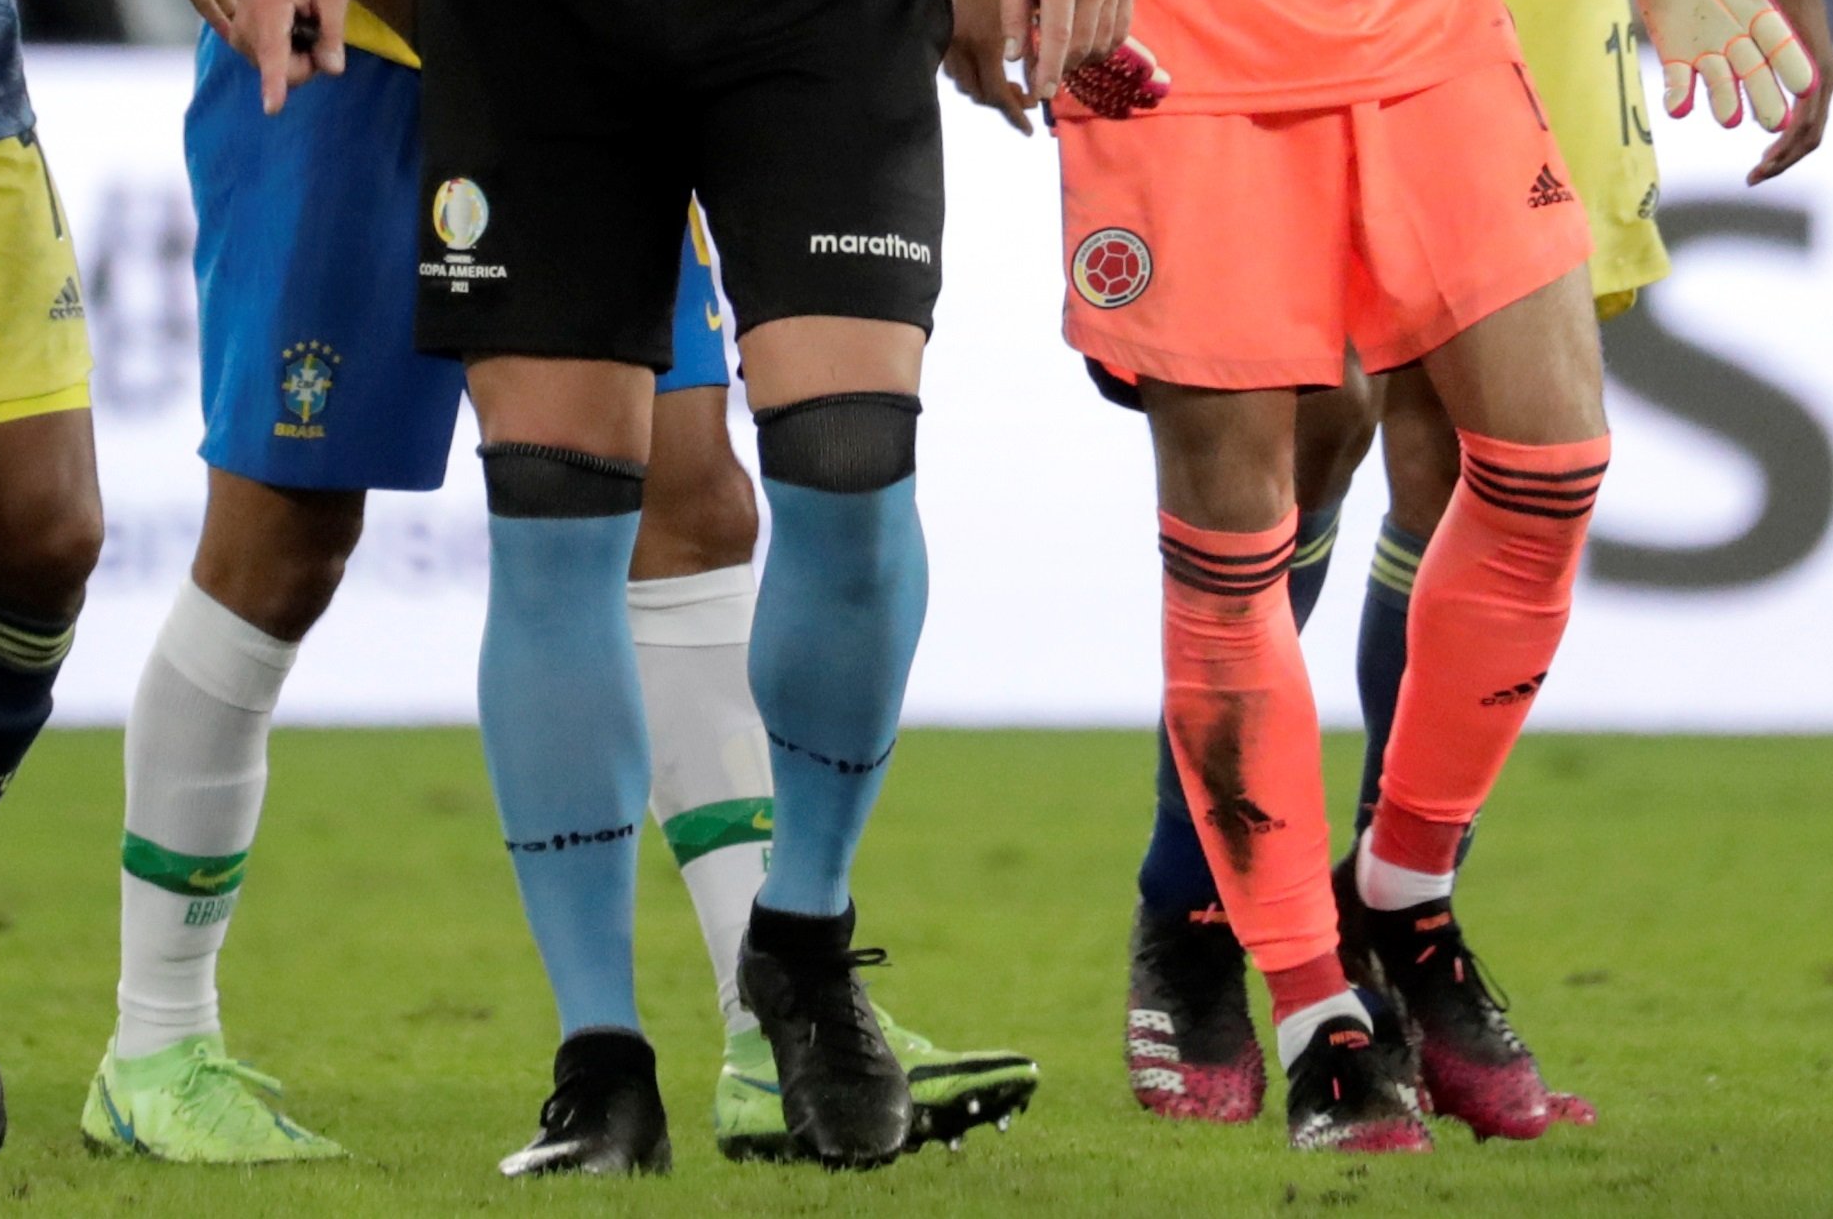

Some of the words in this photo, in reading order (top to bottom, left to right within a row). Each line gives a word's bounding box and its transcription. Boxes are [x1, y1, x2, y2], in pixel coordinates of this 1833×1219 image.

[810, 233, 931, 264] marathon
[419, 263, 447, 276] COPA
[448, 265, 507, 278] AMERICA
[273, 422, 325, 438] BRASIL
